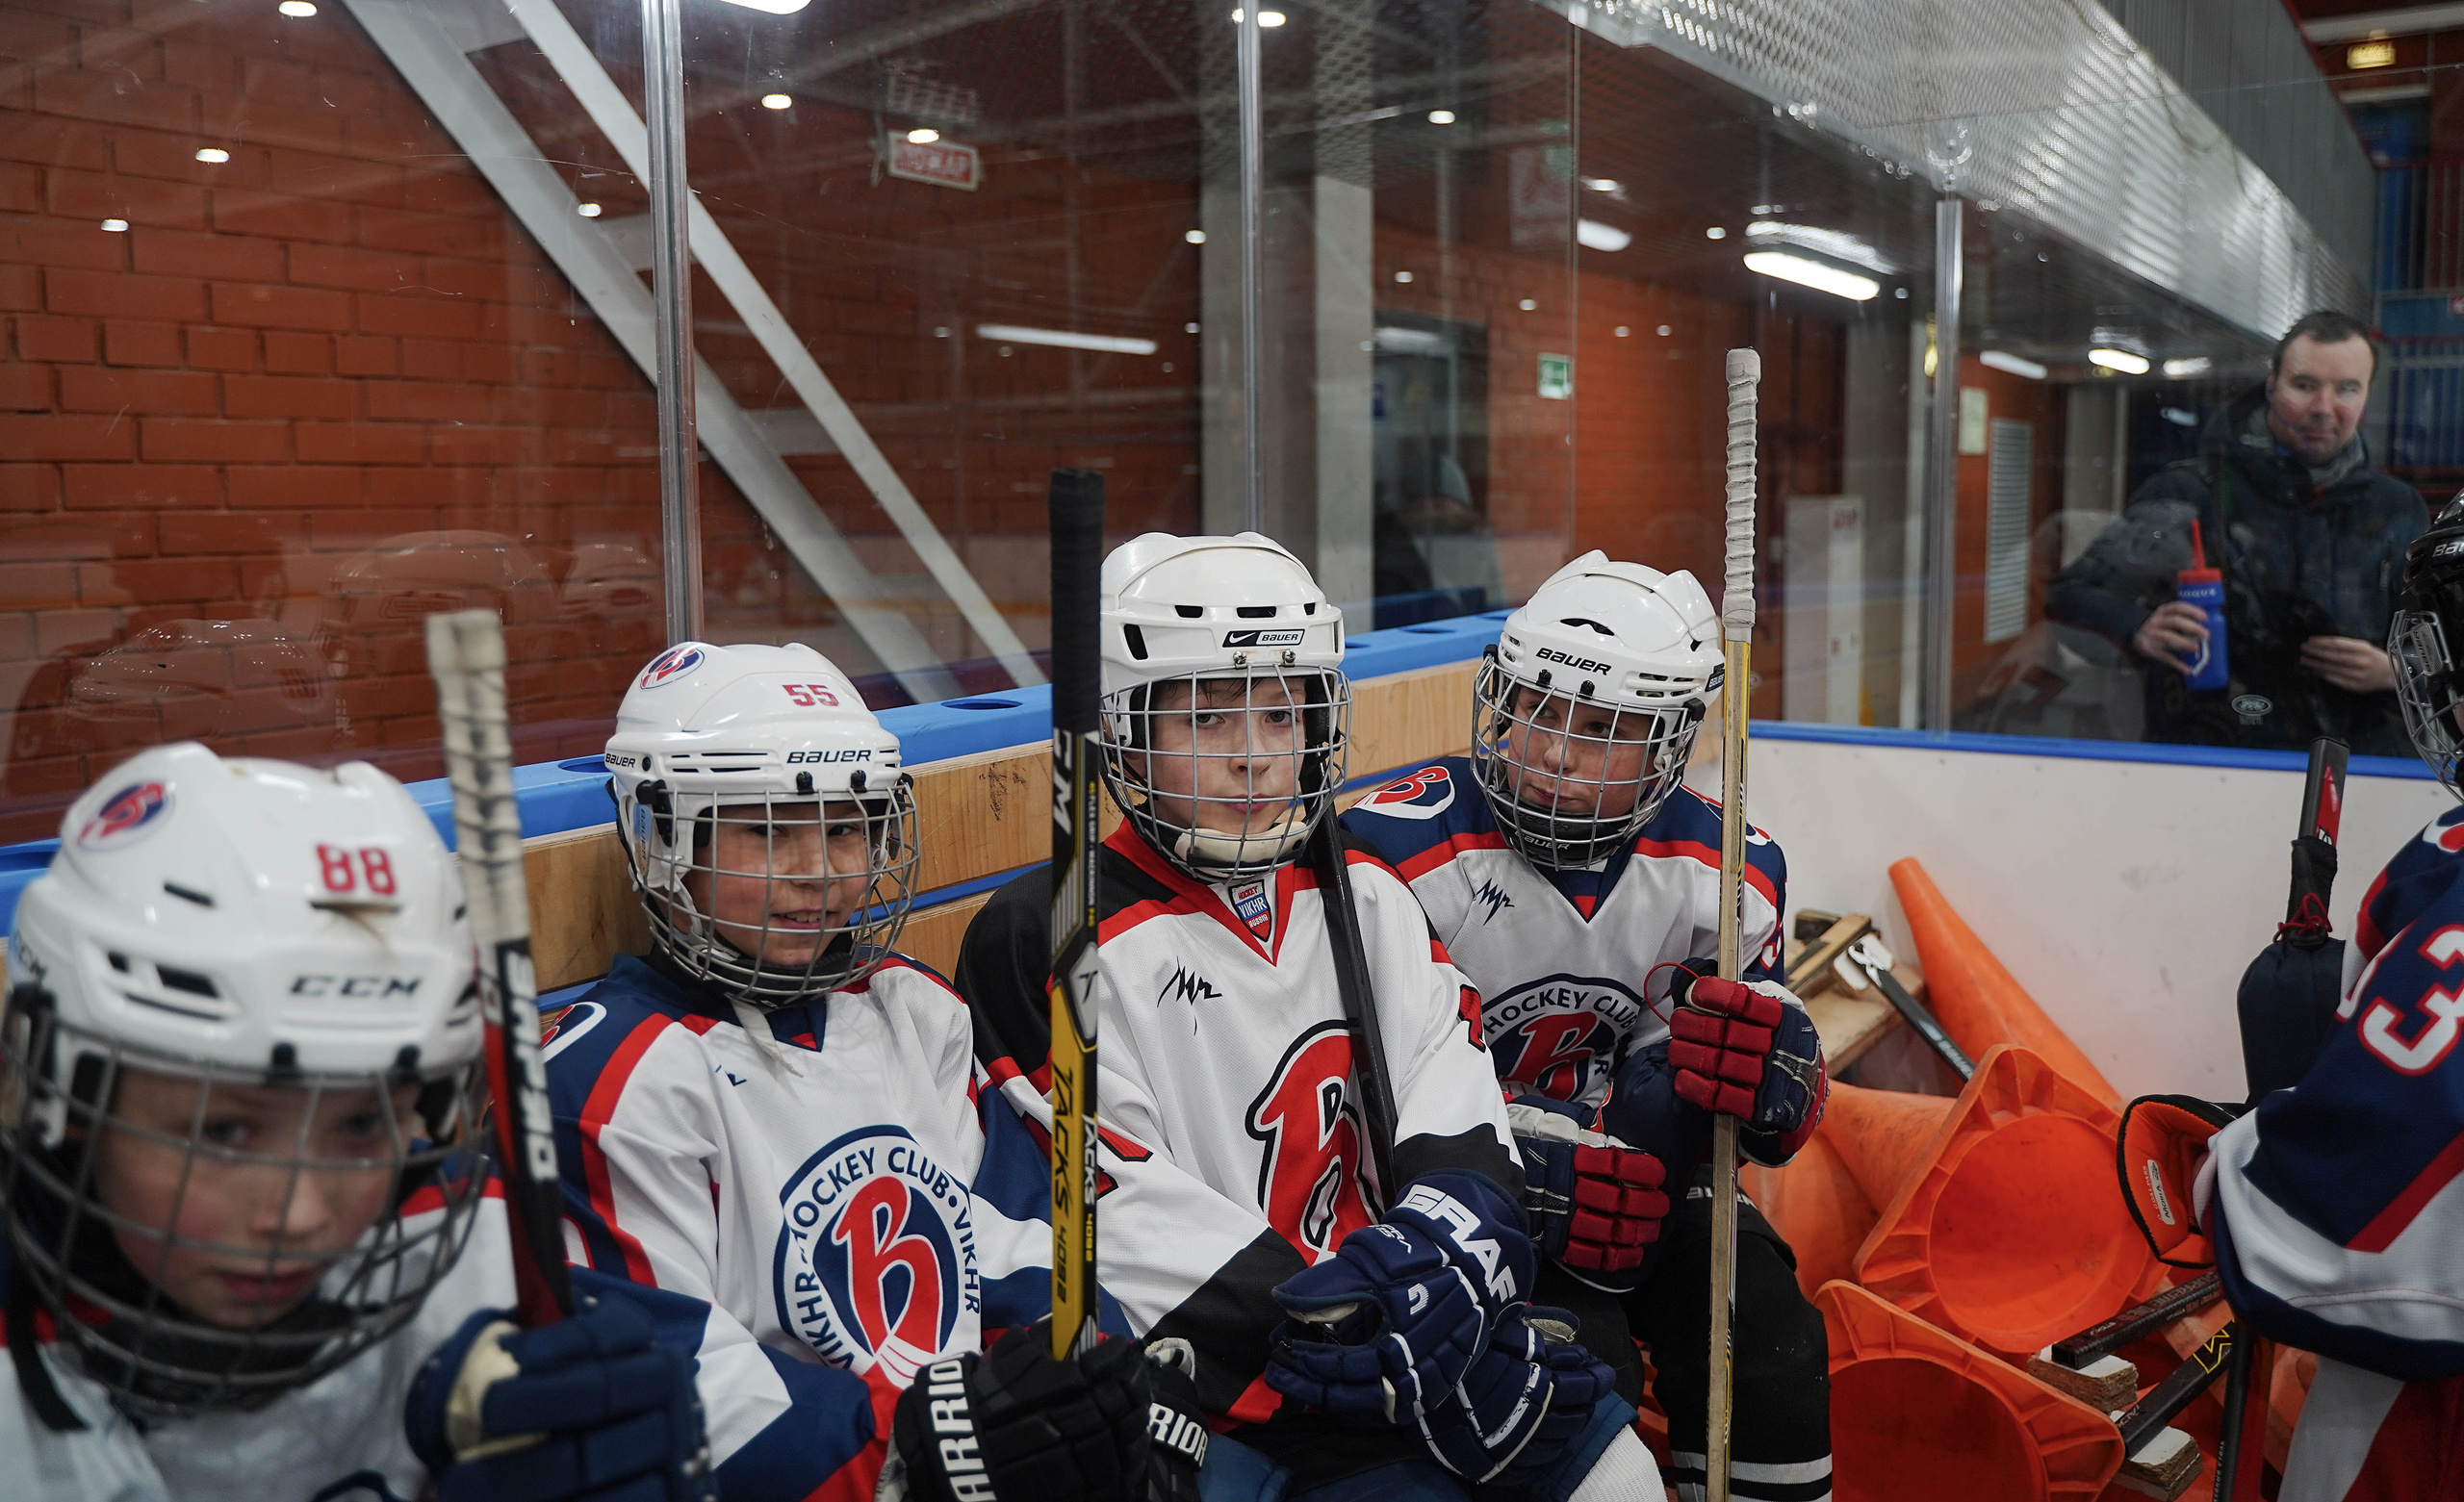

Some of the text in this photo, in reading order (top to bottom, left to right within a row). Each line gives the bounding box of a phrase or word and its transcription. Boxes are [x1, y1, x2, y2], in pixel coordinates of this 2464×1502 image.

[1261, 632, 1298, 642] BAUER
[1536, 647, 1611, 676] BAUER
[782, 684, 839, 707] 55
[604, 752, 636, 768] BAUER
[786, 750, 871, 764] BAUER
[316, 843, 397, 896] 88
[1238, 897, 1268, 918] VIKHR
[290, 972, 424, 998] CCM
[1483, 987, 1637, 1034] HOCKEY CLUB
[1052, 1061, 1073, 1218] TACKS
[1082, 1111, 1097, 1206] TACKS
[887, 1146, 951, 1203] CLUB
[953, 1206, 981, 1314] VIKHR
[1396, 1184, 1517, 1304] GRAF
[794, 1270, 855, 1370] VIKHR
[928, 1359, 998, 1502] ARRIO
[1148, 1402, 1210, 1468] RIOR
